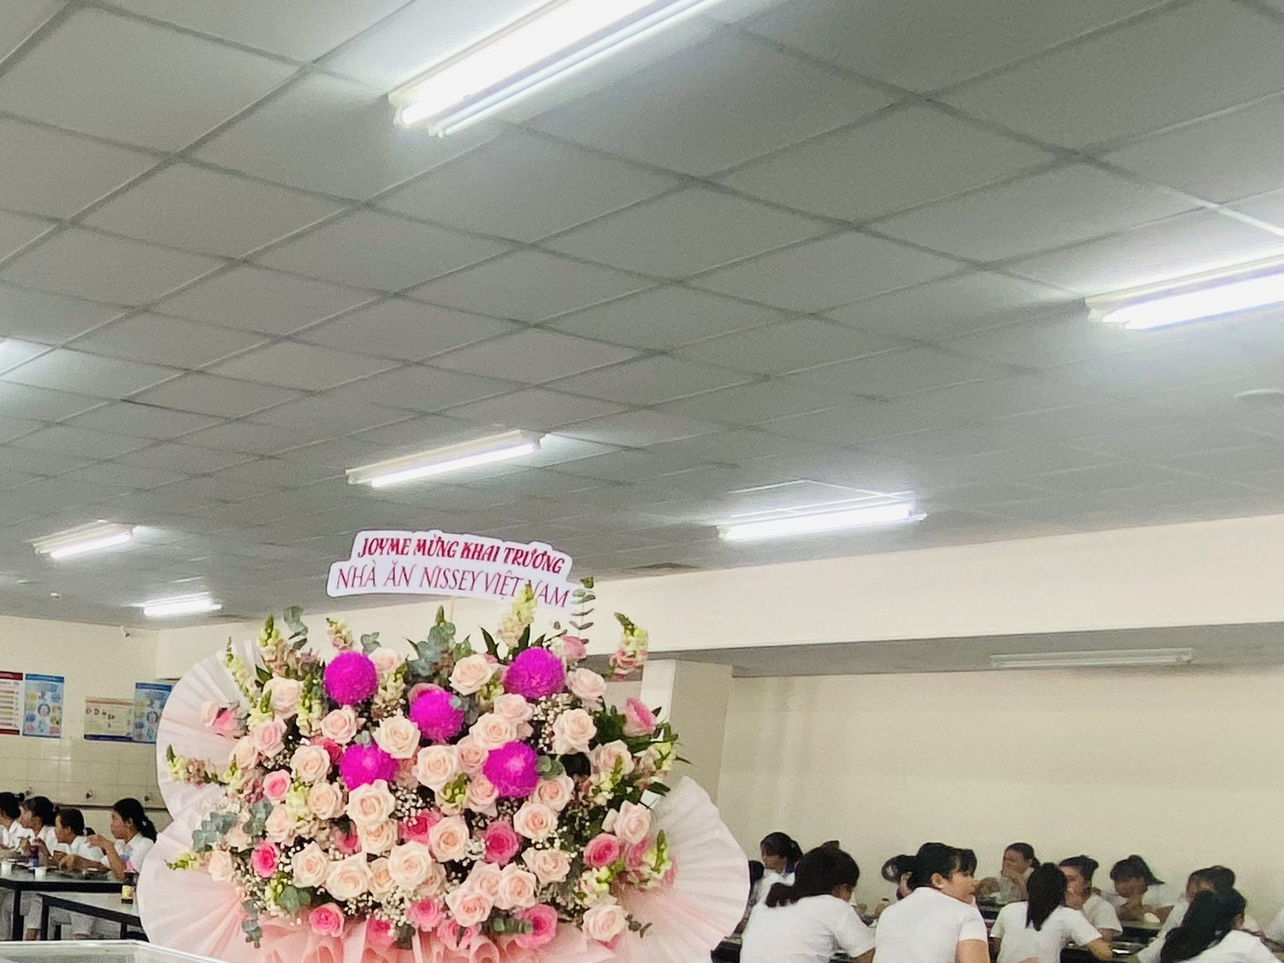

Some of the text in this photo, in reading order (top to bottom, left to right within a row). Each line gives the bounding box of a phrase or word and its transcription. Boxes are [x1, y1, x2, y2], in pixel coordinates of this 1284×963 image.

[358, 533, 565, 574] JOYME MỪNG KHAI TRƯƠNG
[336, 560, 377, 588] NHÀ
[383, 560, 416, 587] ĂN
[419, 566, 484, 592] NISSEY
[485, 569, 524, 601] VIỆT
